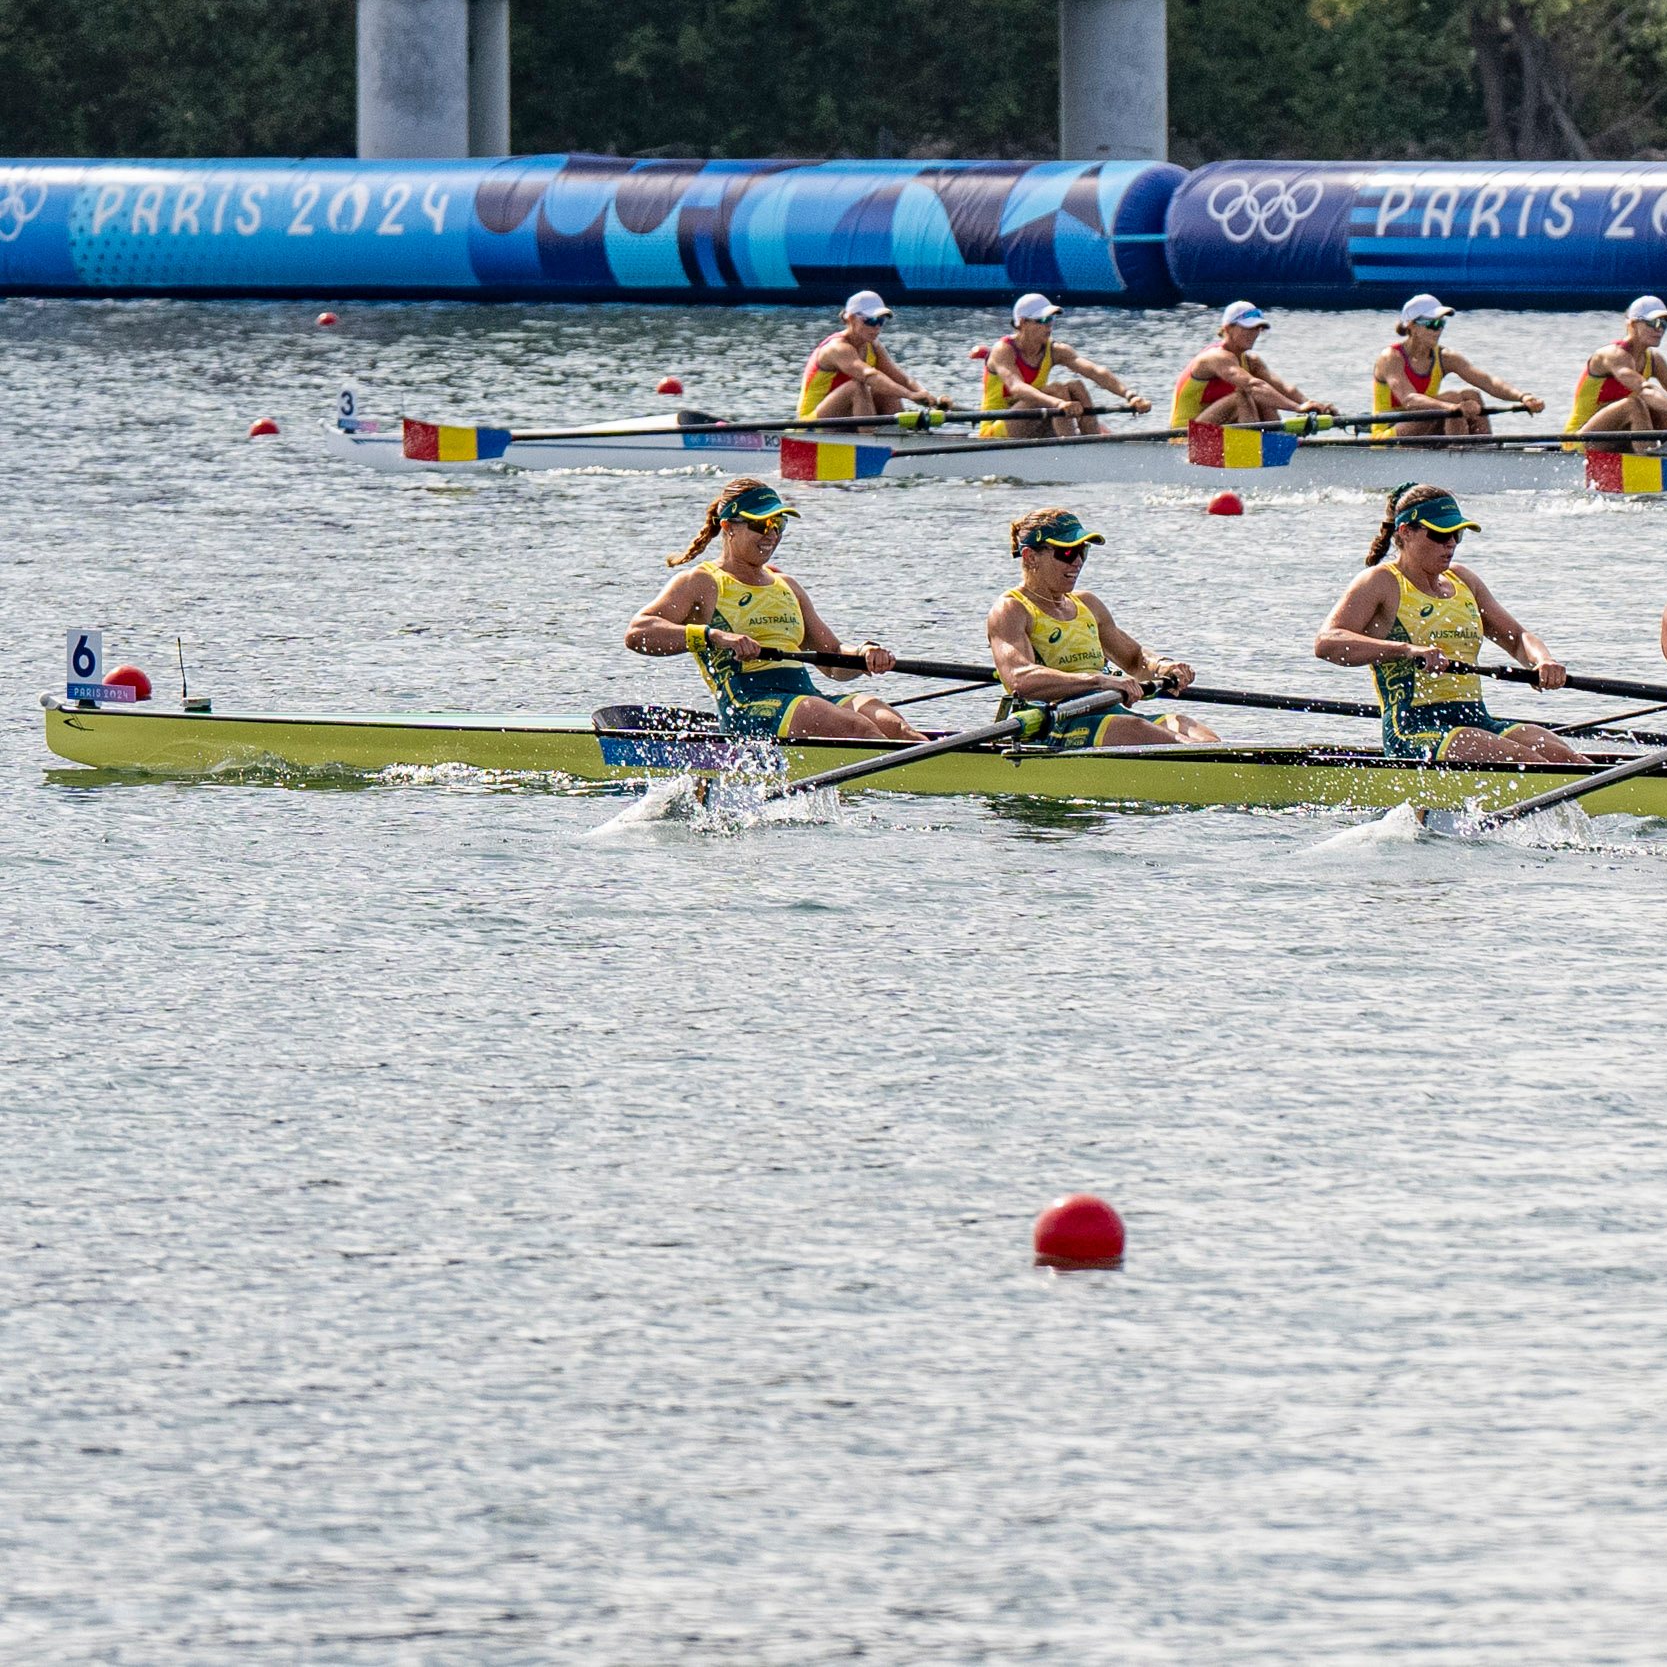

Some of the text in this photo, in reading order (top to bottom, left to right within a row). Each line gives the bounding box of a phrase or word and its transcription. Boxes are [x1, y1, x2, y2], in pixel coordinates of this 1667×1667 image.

[289, 182, 450, 236] 2024
[341, 390, 354, 416] 3
[764, 435, 780, 447] RO
[748, 615, 798, 626] AUSTRALIA
[1429, 629, 1479, 640] AUSTRALIA
[72, 635, 96, 678] 6
